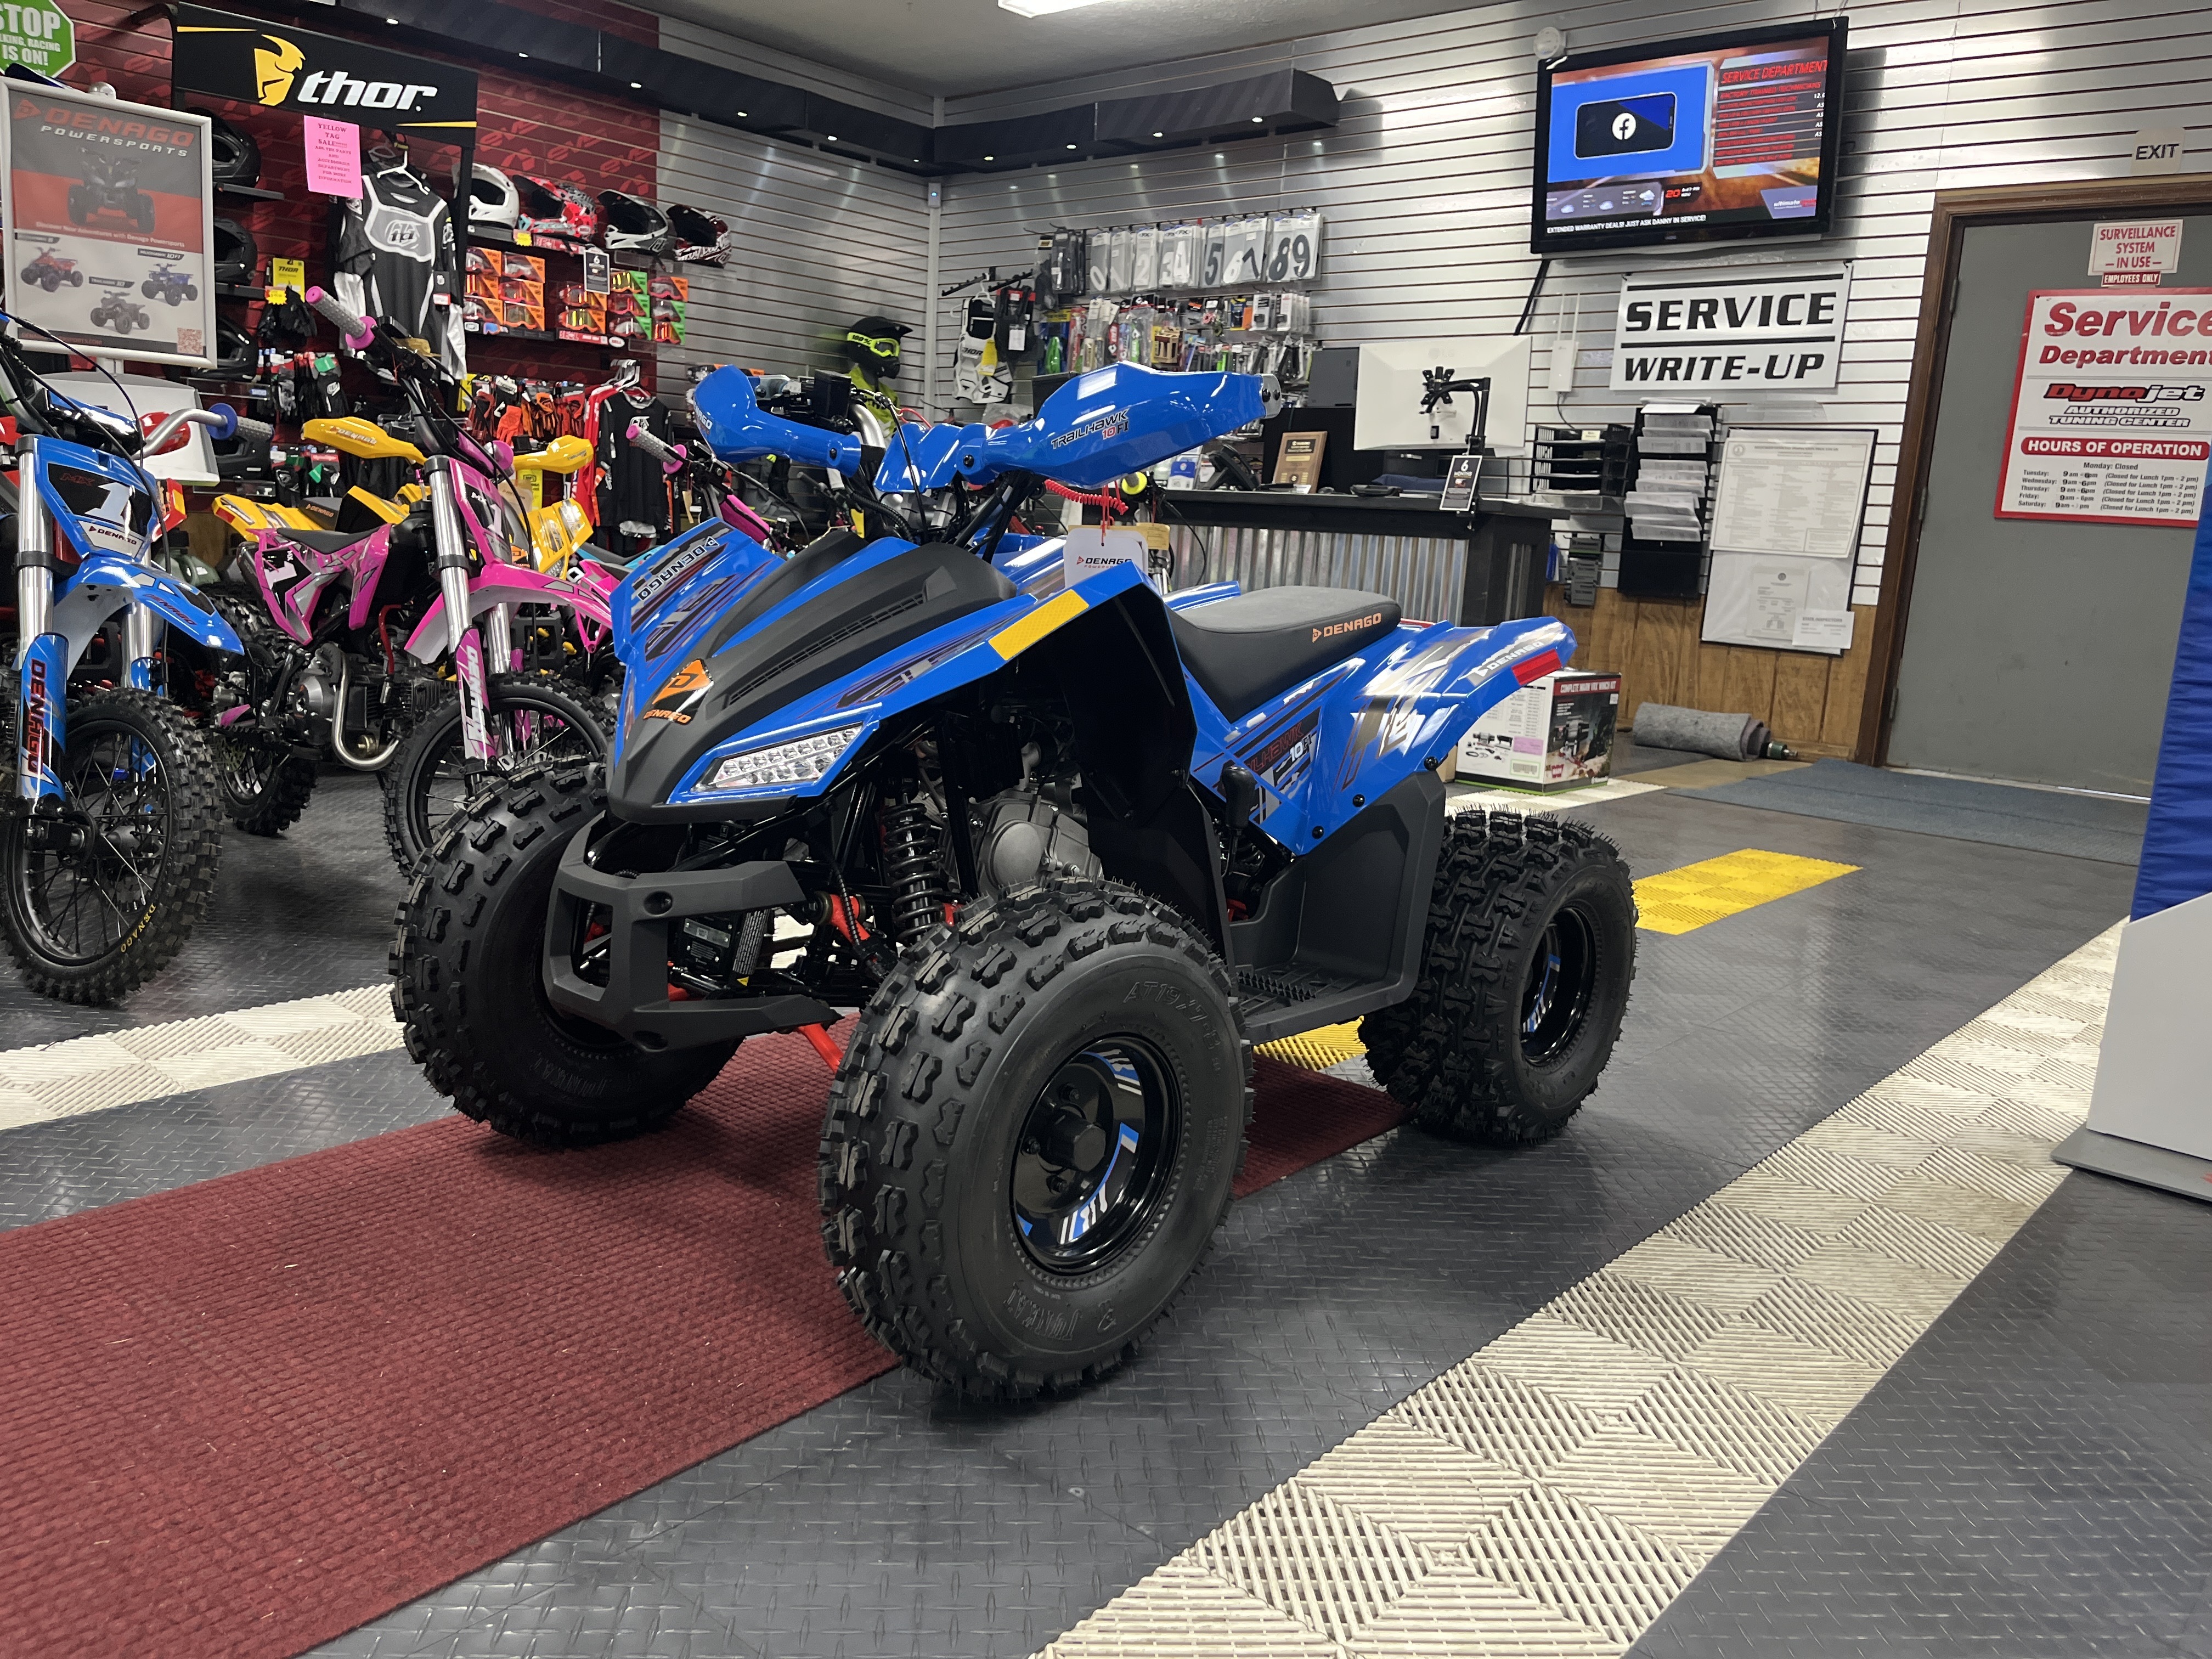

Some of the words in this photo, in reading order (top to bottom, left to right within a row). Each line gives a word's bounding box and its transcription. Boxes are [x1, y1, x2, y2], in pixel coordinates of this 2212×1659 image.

[0, 3, 61, 40] TOP
[2, 44, 19, 61] IS
[21, 47, 48, 66] ON!
[27, 38, 61, 52] RACING
[1721, 67, 1760, 83] SERVICE
[1761, 59, 1828, 80] DEPARTMENT
[44, 107, 195, 148] DENAGO
[318, 123, 347, 132] YELLOW
[40, 125, 188, 157] POWERSPORTS
[2135, 143, 2180, 160] EXIT
[127, 233, 149, 242] Denago
[150, 237, 185, 247] Powersports
[2100, 225, 2176, 240] SURVEILLANCE
[1293, 234, 1310, 278] 9
[2115, 241, 2155, 254] SYSTEM
[593, 255, 600, 264] 6
[1205, 242, 1223, 286] 5
[1242, 247, 1261, 279] 7
[1269, 237, 1291, 281] 8
[2117, 257, 2129, 268] IN
[2131, 256, 2151, 268] USE
[2104, 274, 2140, 284] EMPLOYEES
[2142, 273, 2158, 283] ONLY
[1626, 292, 1836, 332] SERVICE
[852, 334, 872, 345] 100%
[1625, 353, 1825, 381] WRITE-UP
[2039, 345, 2212, 368] Departmen
[2044, 383, 2206, 403] Dynojet
[2049, 415, 2118, 426] TUNING
[2119, 416, 2191, 427] CENTER
[2064, 405, 2181, 416] AUTHORIZED
[338, 428, 377, 447] DENAGO
[2028, 440, 2081, 453] HOURS
[2086, 441, 2107, 453] OF
[2111, 442, 2202, 456] OPERATION
[1460, 460, 1469, 472] 6
[60, 472, 95, 487] MX
[471, 492, 487, 504] MX
[311, 505, 334, 518] DENAGO
[636, 543, 708, 602] DENAGO
[145, 593, 198, 626] DENAGO
[1323, 612, 1383, 638] DENAGO
[1486, 641, 1544, 670] DENAGO
[466, 645, 487, 740] DENAGO
[26, 658, 47, 775] DENAGO
[120, 901, 157, 953] DENAGO
